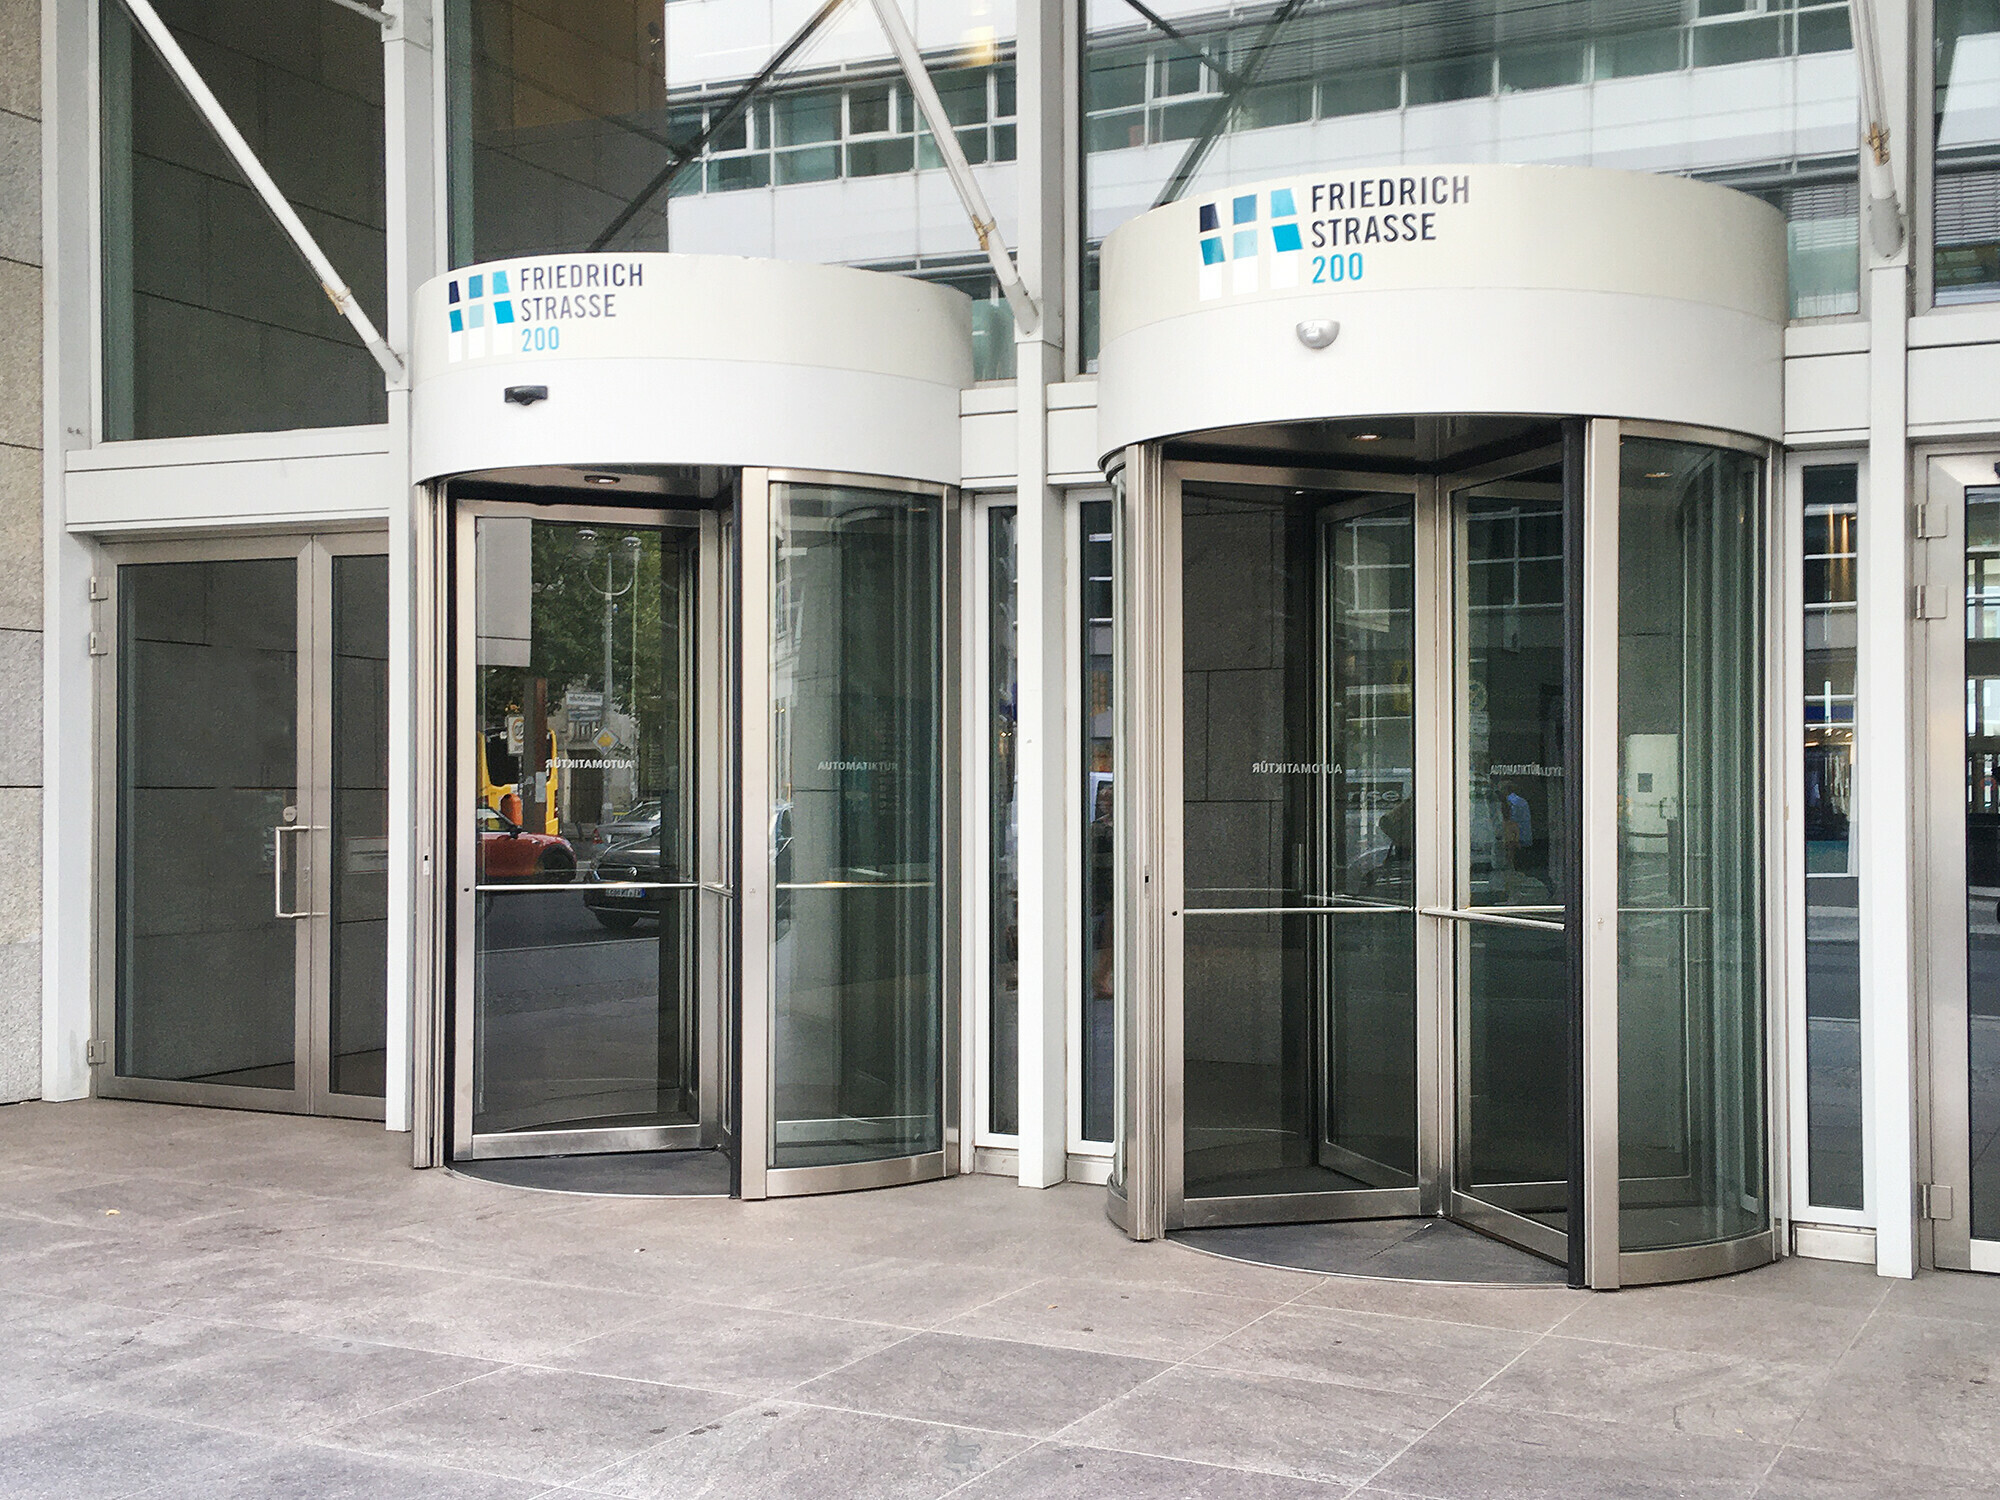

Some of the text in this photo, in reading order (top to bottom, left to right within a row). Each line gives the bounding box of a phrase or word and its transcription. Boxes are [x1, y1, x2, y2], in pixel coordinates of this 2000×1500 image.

[1311, 175, 1470, 212] FRIEDRICH
[1311, 213, 1436, 248] STRASSE
[520, 263, 643, 291] FRIEDRICH
[1312, 252, 1364, 284] 200
[521, 294, 616, 322] STRASSE
[521, 326, 560, 352] 200
